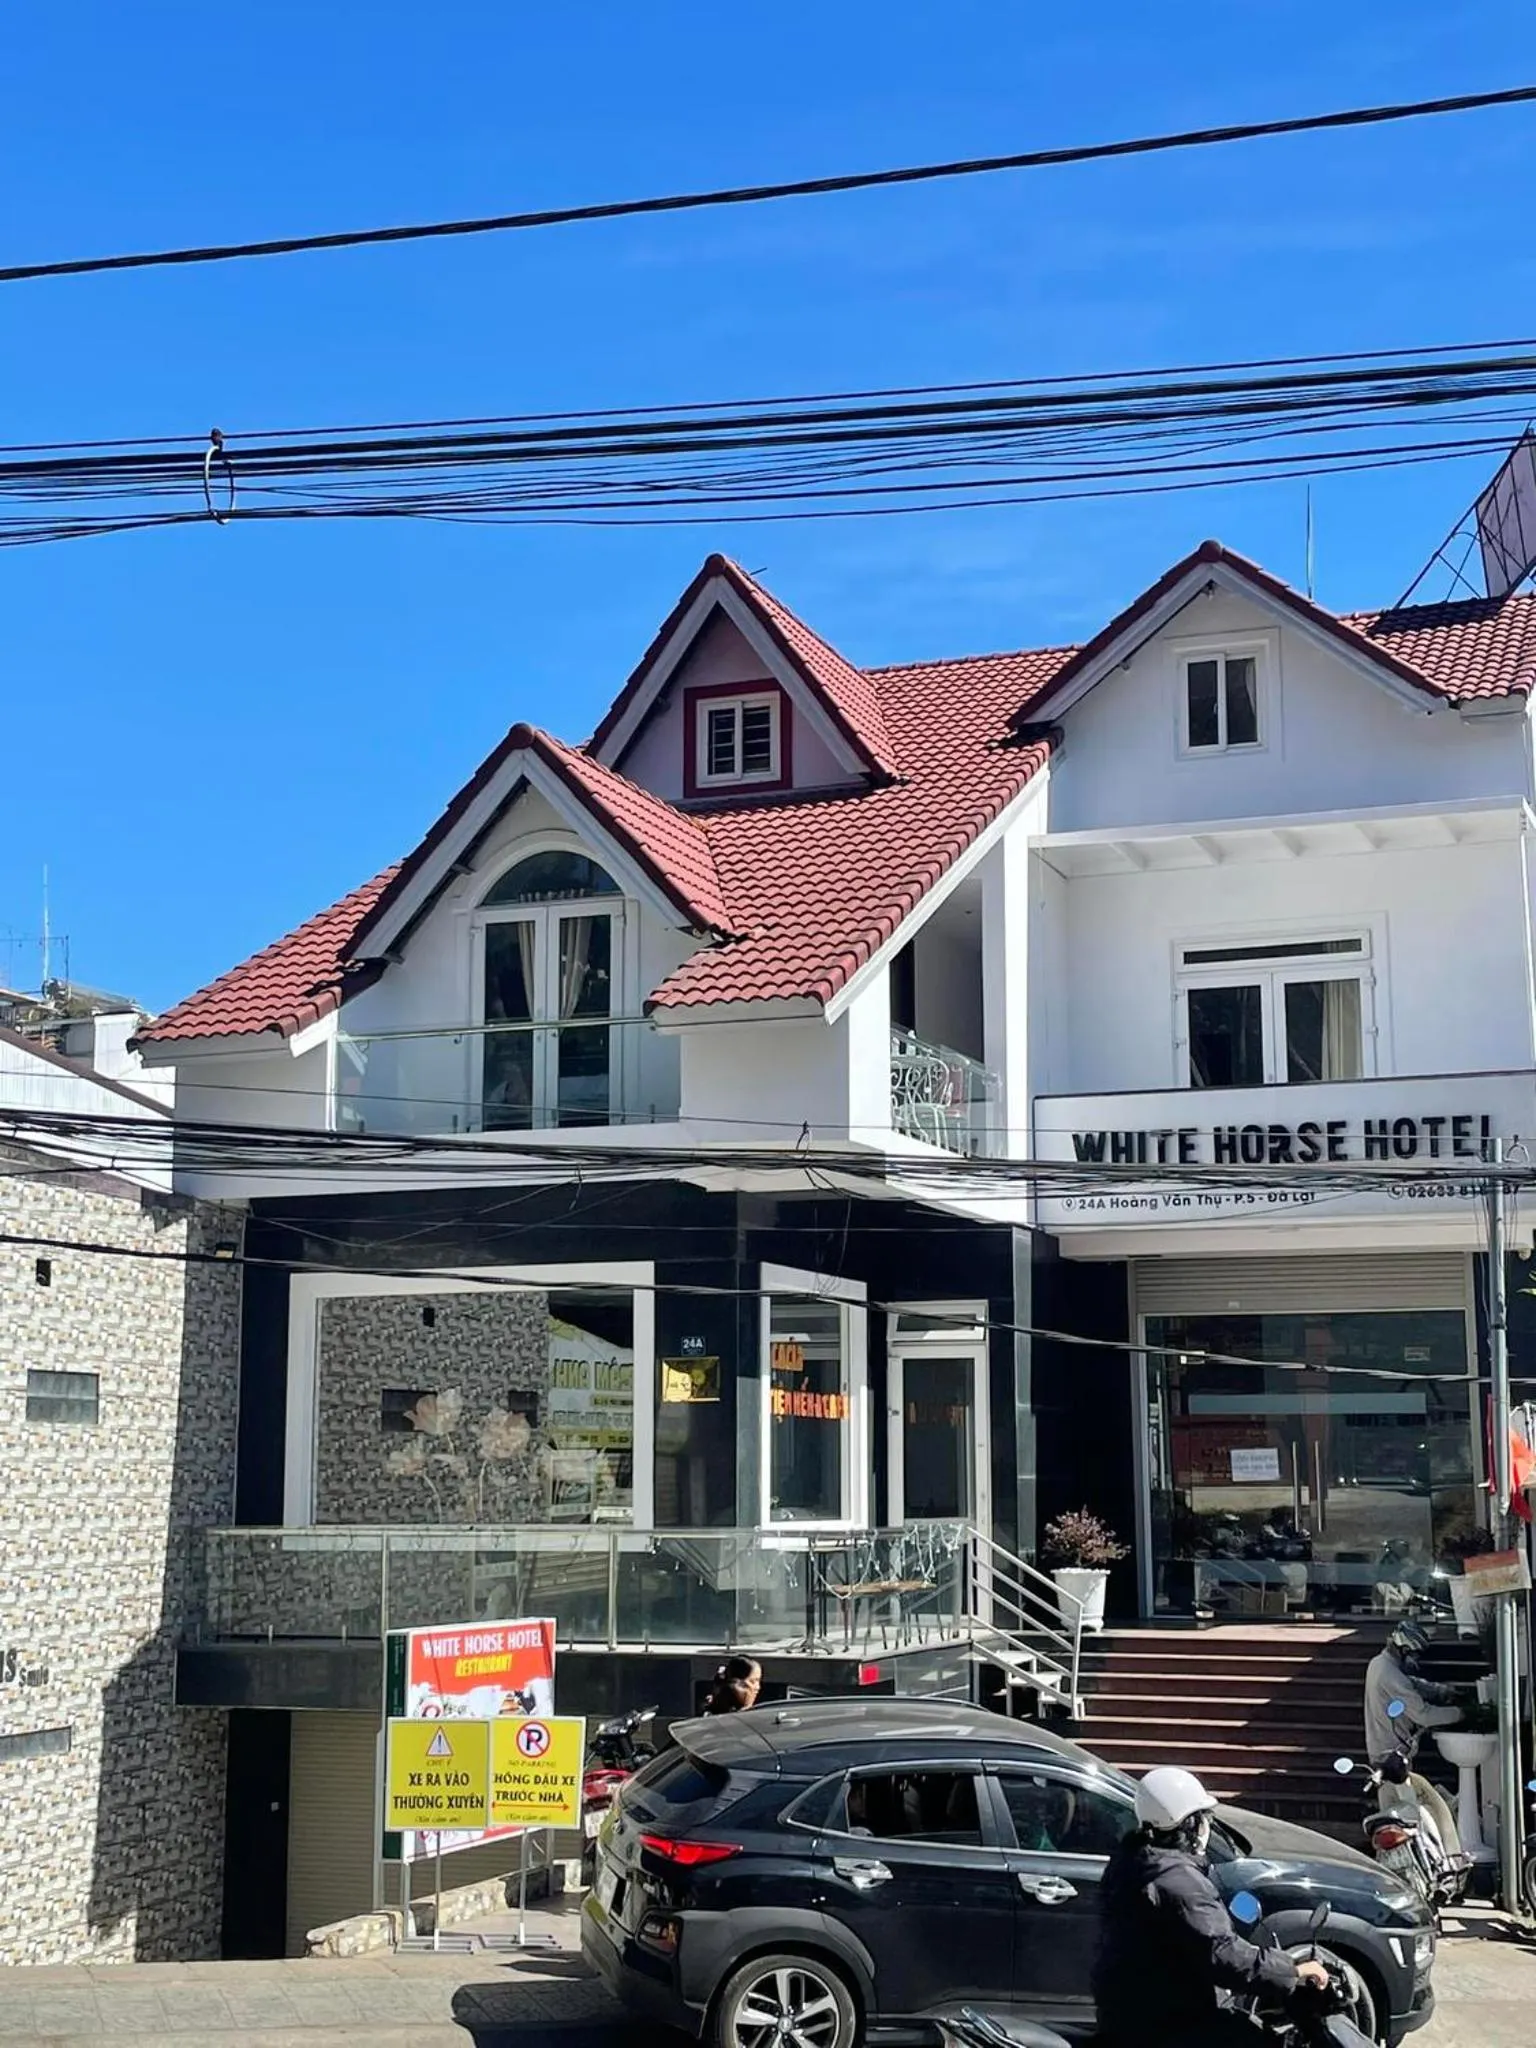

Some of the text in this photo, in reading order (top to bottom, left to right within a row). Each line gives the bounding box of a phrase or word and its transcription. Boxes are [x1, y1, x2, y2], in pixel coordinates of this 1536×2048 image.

[1072, 1127, 1198, 1165] WHITE
[1214, 1120, 1348, 1164] HORSE
[1078, 1198, 1106, 1210] 24A
[1110, 1196, 1158, 1210] Hoàng
[1162, 1193, 1191, 1206] Văn
[1196, 1193, 1222, 1208] Thụ
[1267, 1191, 1288, 1202] Đà
[683, 1338, 703, 1349] 24A
[422, 1637, 461, 1659] WHITE
[464, 1632, 505, 1655] HORSE
[507, 1629, 544, 1650] HOTEL
[455, 1654, 513, 1677] RESTAURANT
[409, 1770, 470, 1787] XE RA VÀO
[562, 1775, 576, 1786] XE
[538, 1790, 565, 1803] NHÀ
